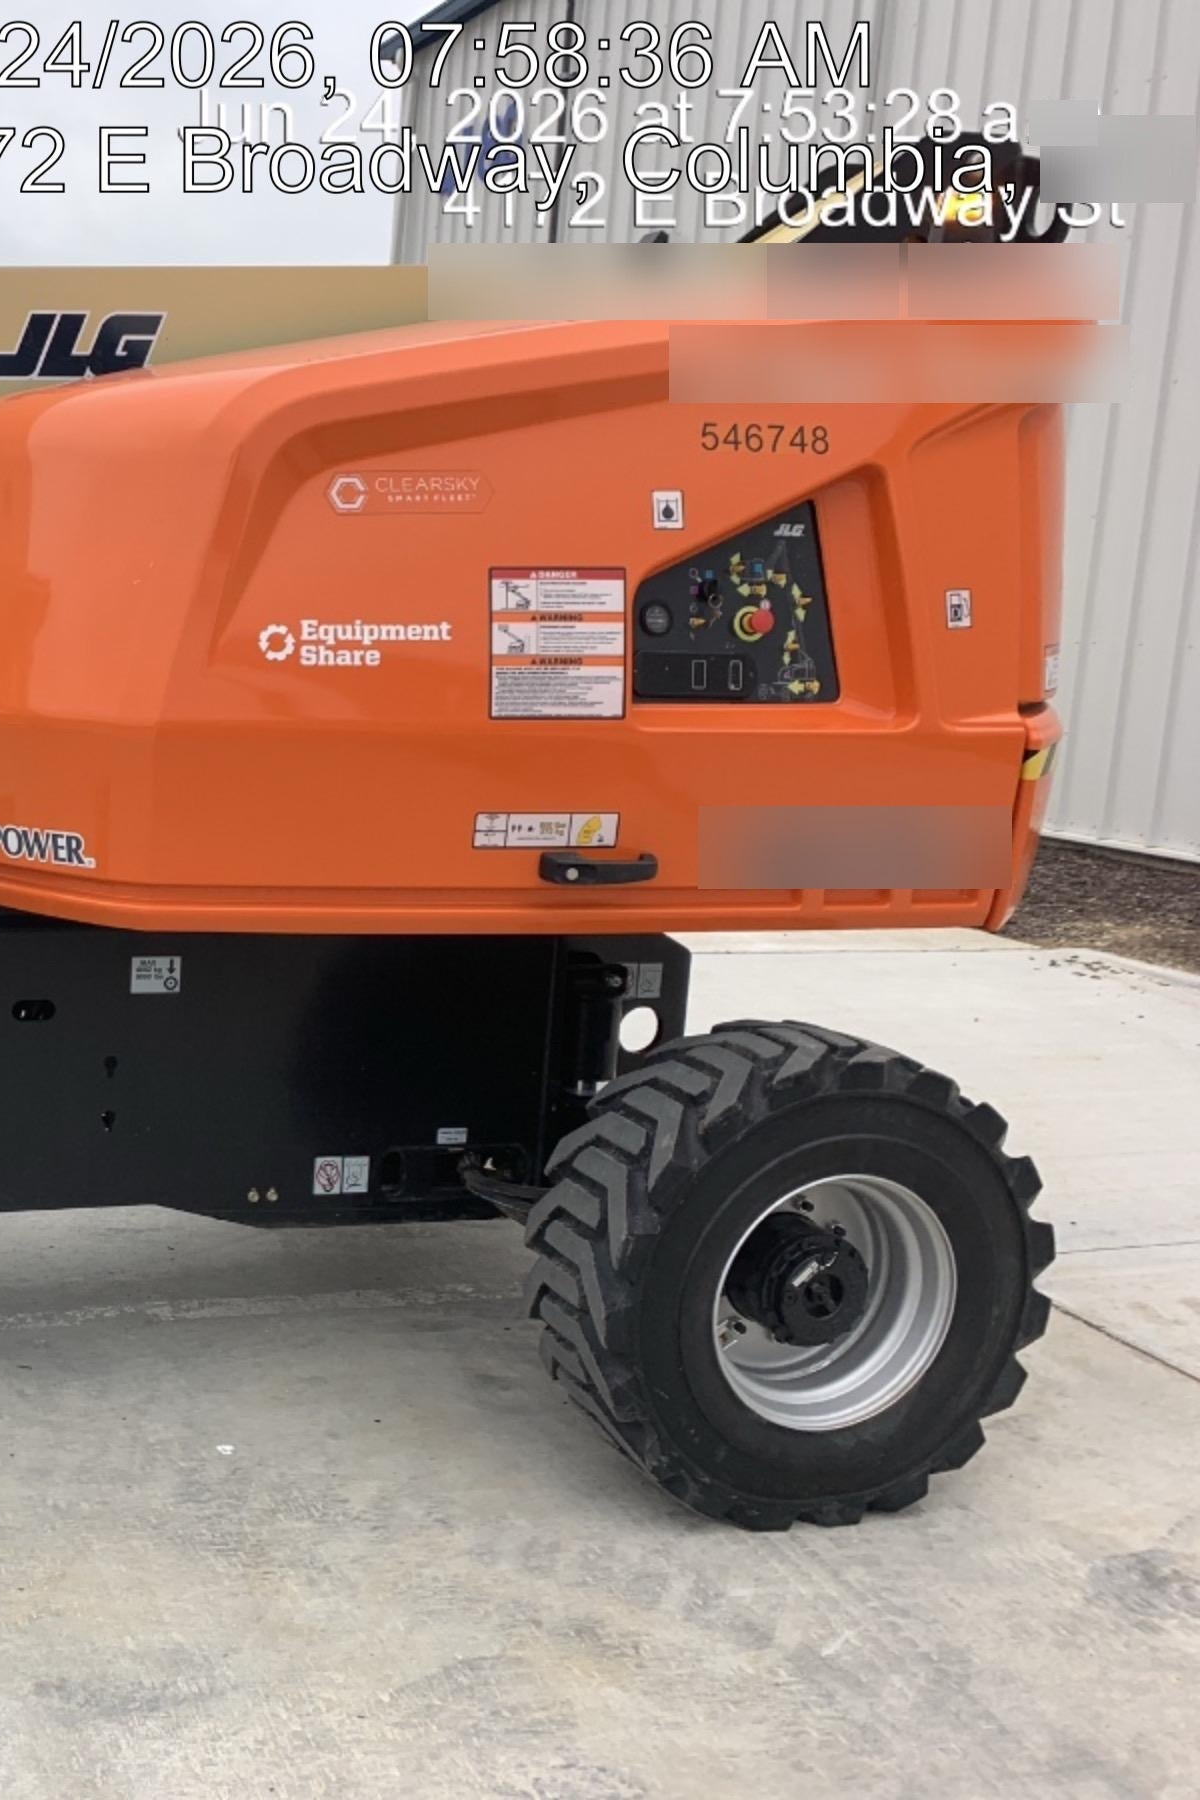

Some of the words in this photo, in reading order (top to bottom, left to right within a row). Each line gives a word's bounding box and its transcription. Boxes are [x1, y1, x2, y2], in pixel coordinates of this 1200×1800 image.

[701, 421, 830, 456] 546748
[375, 476, 481, 494] CLEARSKY
[773, 523, 806, 538] JLG
[300, 619, 453, 645] Equipment
[300, 645, 381, 668] Share
